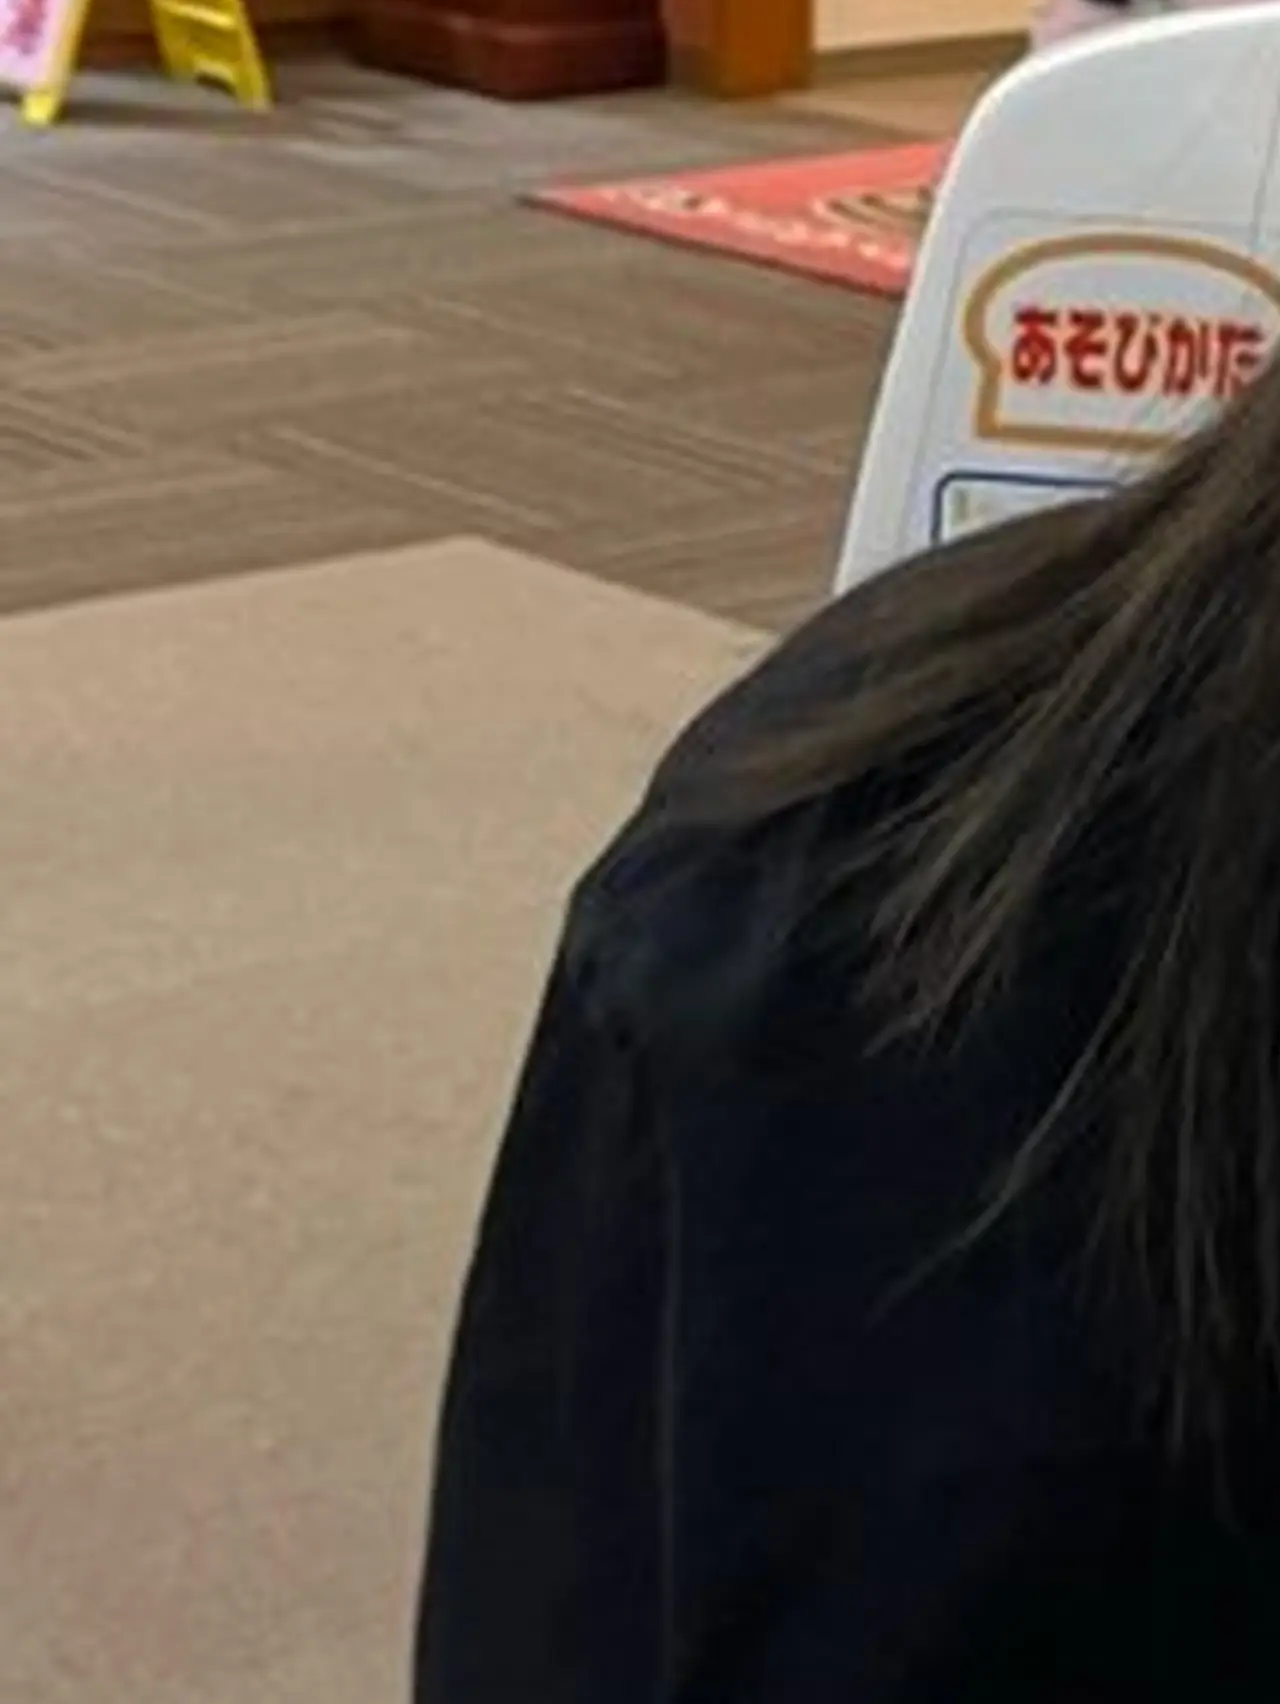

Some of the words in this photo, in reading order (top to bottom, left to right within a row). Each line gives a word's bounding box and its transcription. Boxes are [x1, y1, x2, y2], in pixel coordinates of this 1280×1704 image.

[1012, 307, 1264, 400] あそびかた
